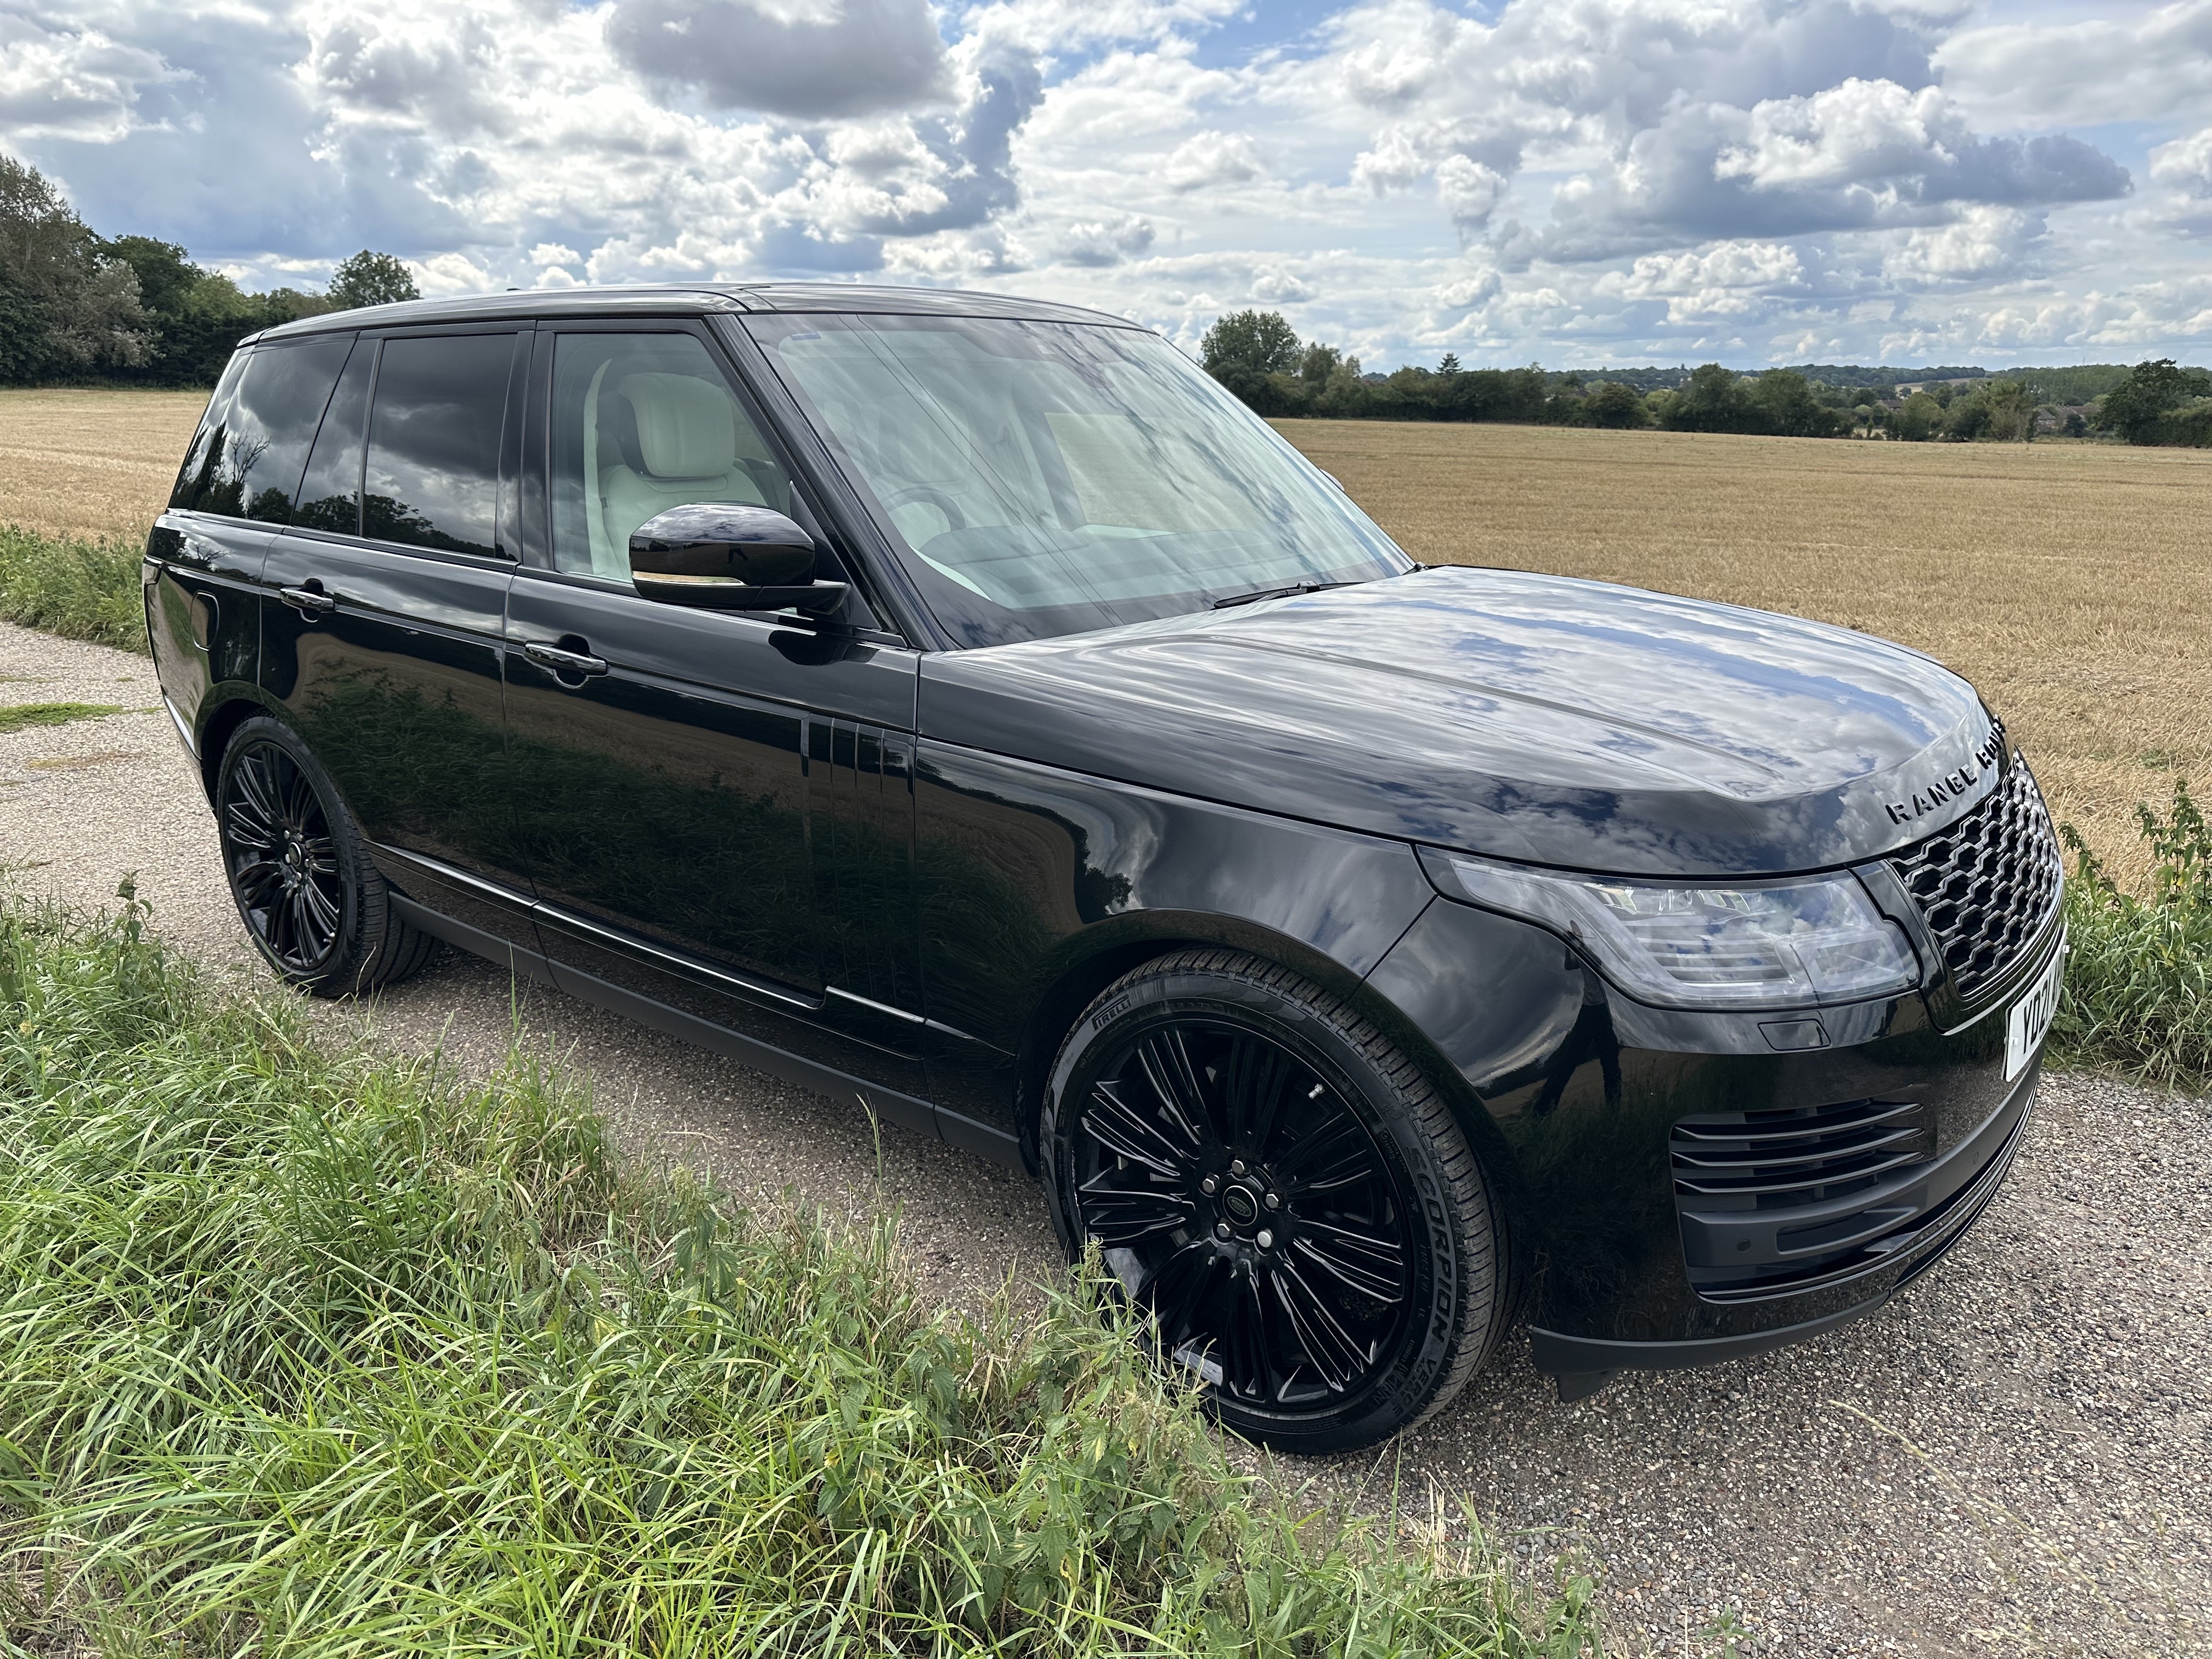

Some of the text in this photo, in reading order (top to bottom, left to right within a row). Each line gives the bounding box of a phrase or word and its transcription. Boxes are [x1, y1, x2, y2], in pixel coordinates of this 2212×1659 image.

[1885, 764, 1978, 825] RANGE
[1091, 994, 1132, 1031] PIRELLI
[1392, 1146, 1453, 1417] SCORPION VERDE
